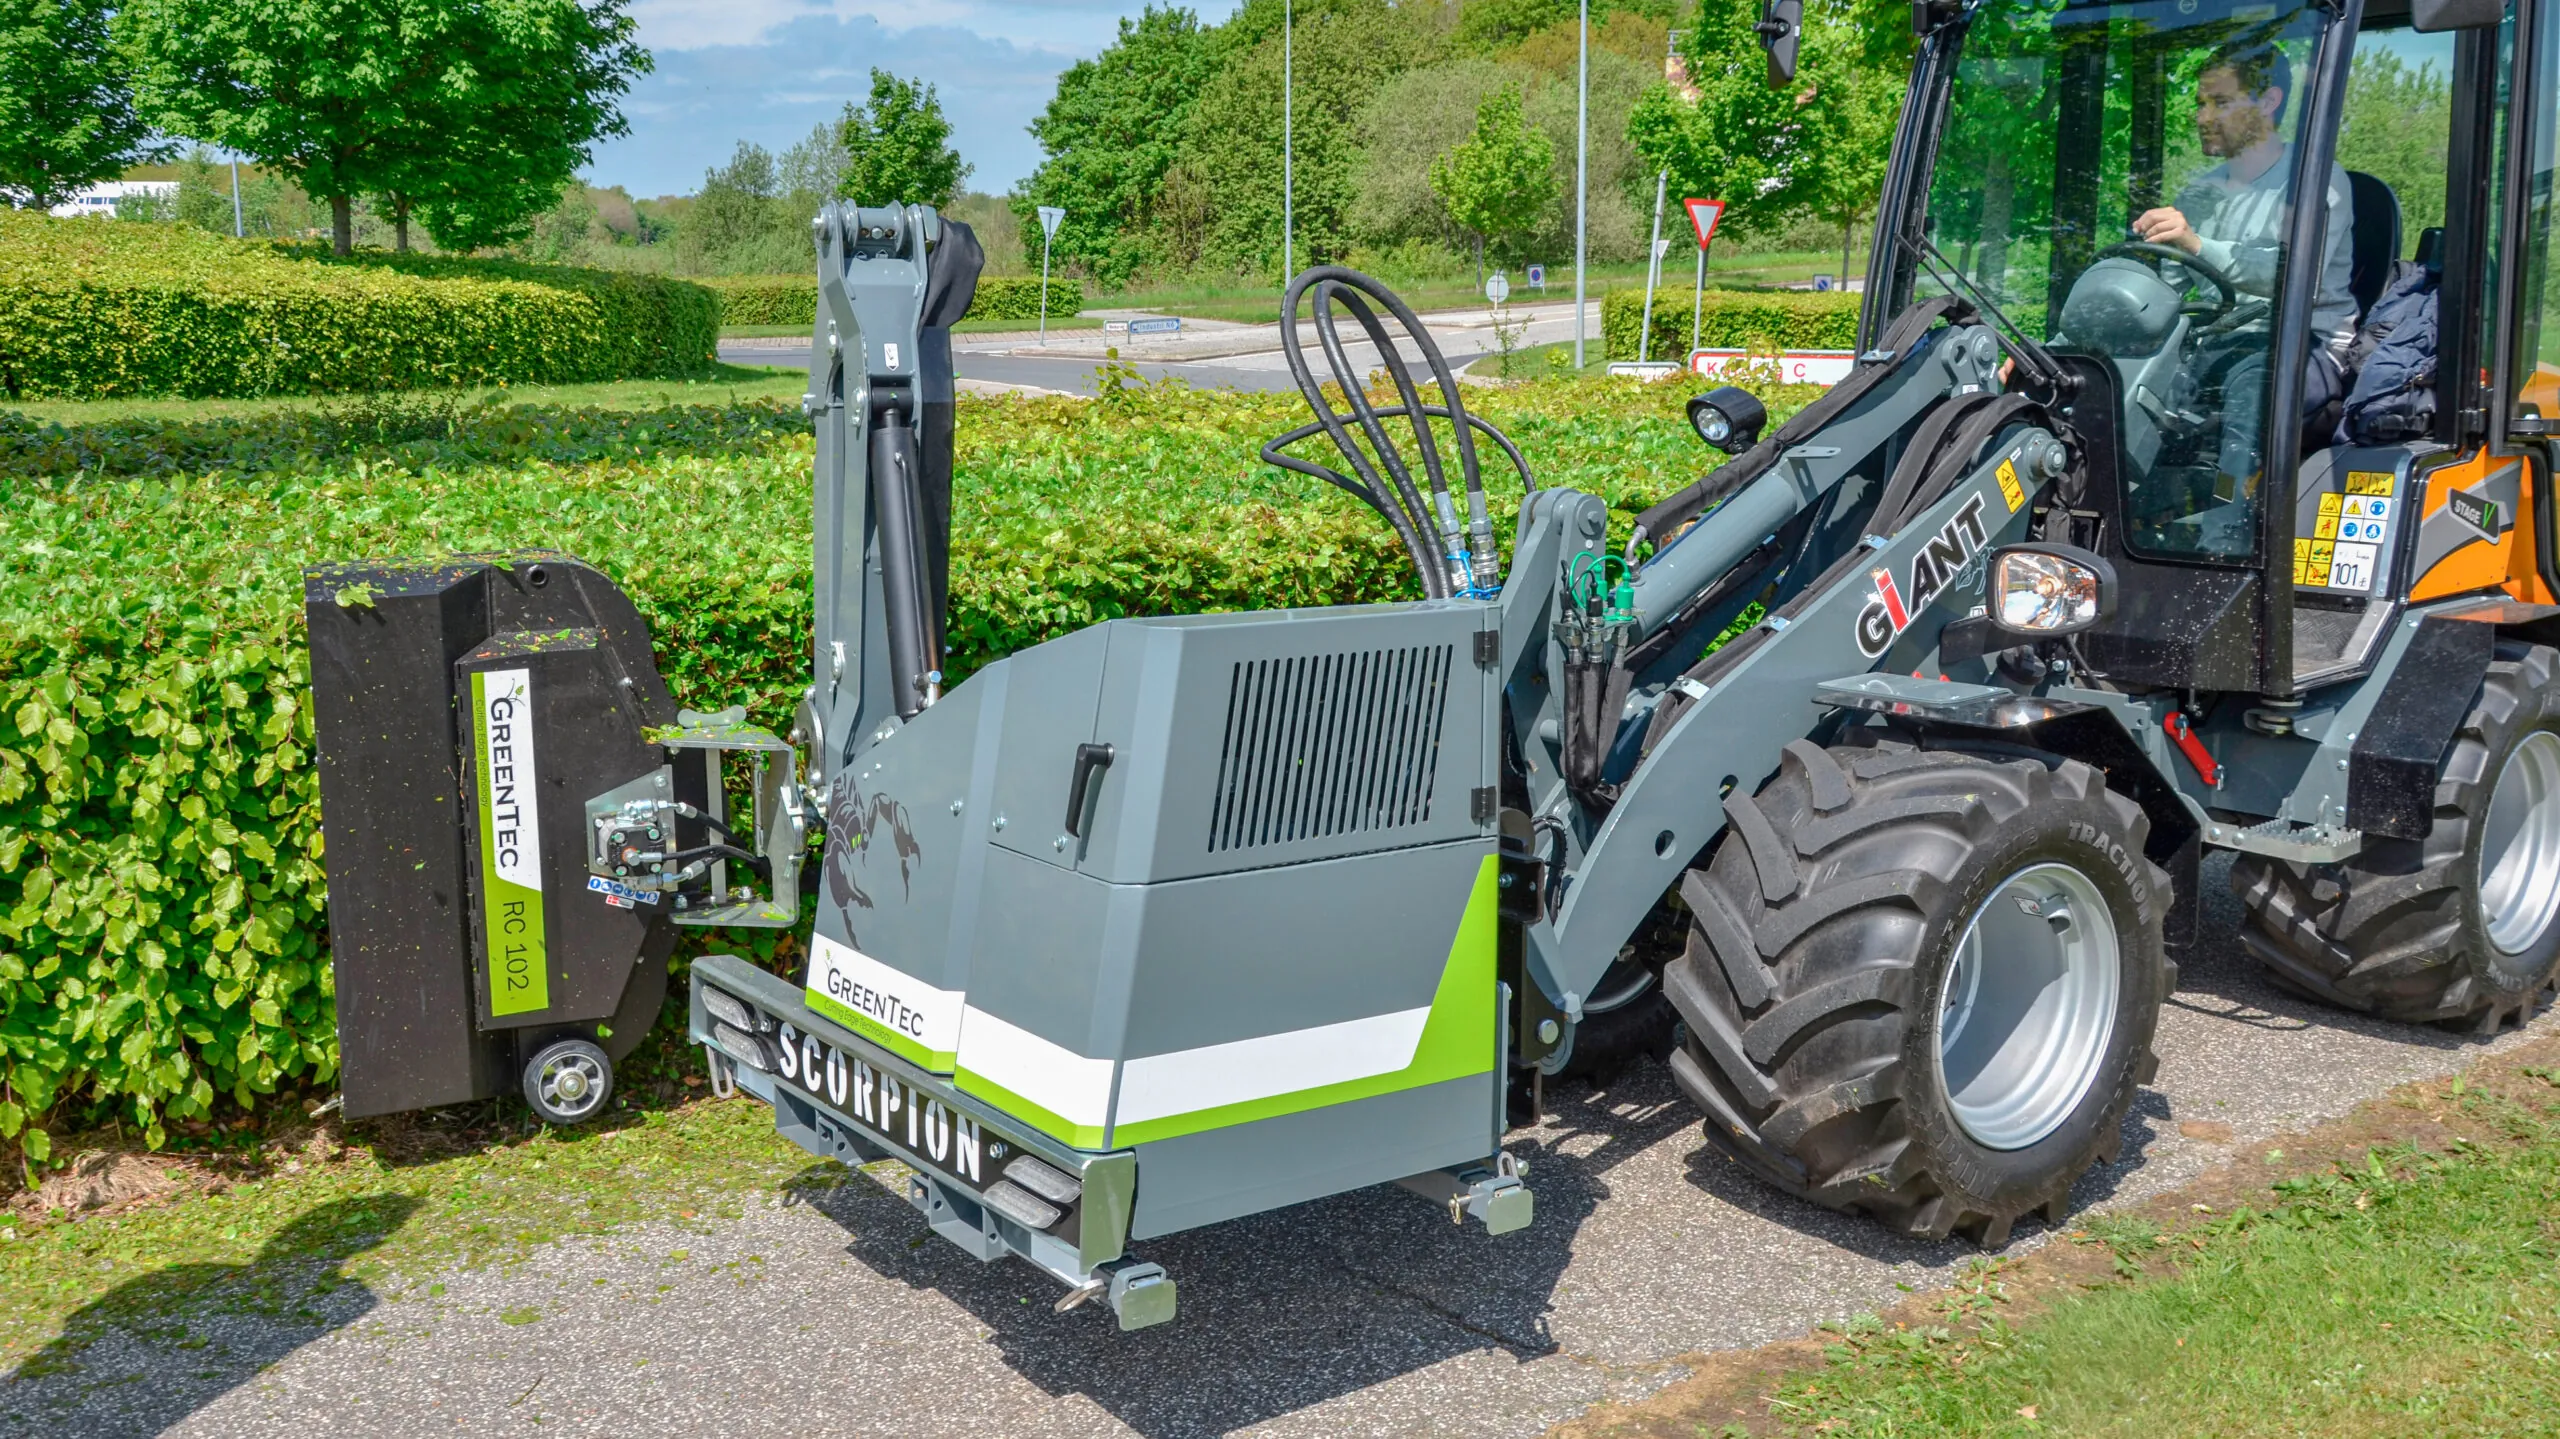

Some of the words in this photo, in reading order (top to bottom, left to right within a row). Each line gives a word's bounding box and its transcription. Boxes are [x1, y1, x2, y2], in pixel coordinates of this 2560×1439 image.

[1793, 363, 1806, 378] C
[2454, 499, 2482, 525] STAGE
[2482, 501, 2498, 529] V
[2335, 562, 2359, 587] 101
[475, 699, 483, 731] Cutting
[476, 733, 486, 755] Edge
[478, 758, 488, 807] Technology
[2068, 819, 2152, 926] TRACTION
[503, 901, 526, 935] RC
[506, 943, 529, 991] 102
[824, 999, 845, 1020] Cutting
[844, 1008, 859, 1028] Edge
[859, 1017, 893, 1045] Technology
[779, 1022, 981, 1183] SCORPION
